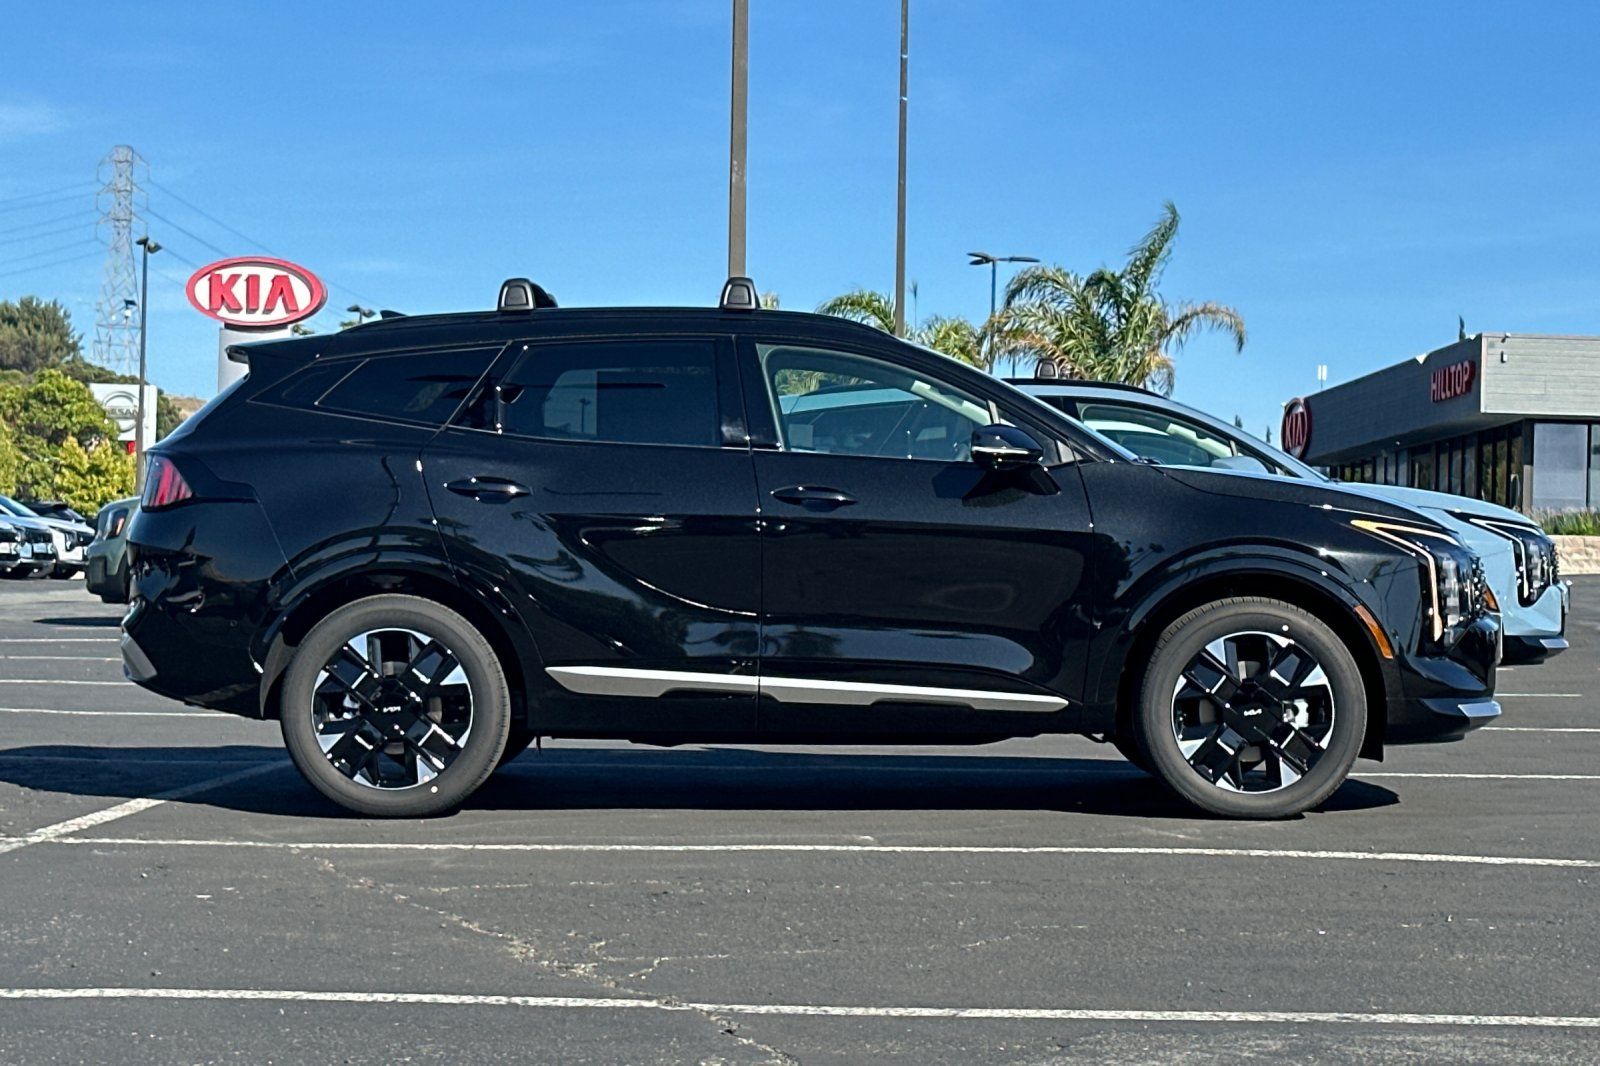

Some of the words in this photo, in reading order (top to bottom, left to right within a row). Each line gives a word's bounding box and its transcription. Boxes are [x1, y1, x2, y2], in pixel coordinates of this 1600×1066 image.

[208, 273, 299, 314] KIA
[1431, 360, 1470, 402] HILLTOP
[1285, 412, 1304, 449] KIA
